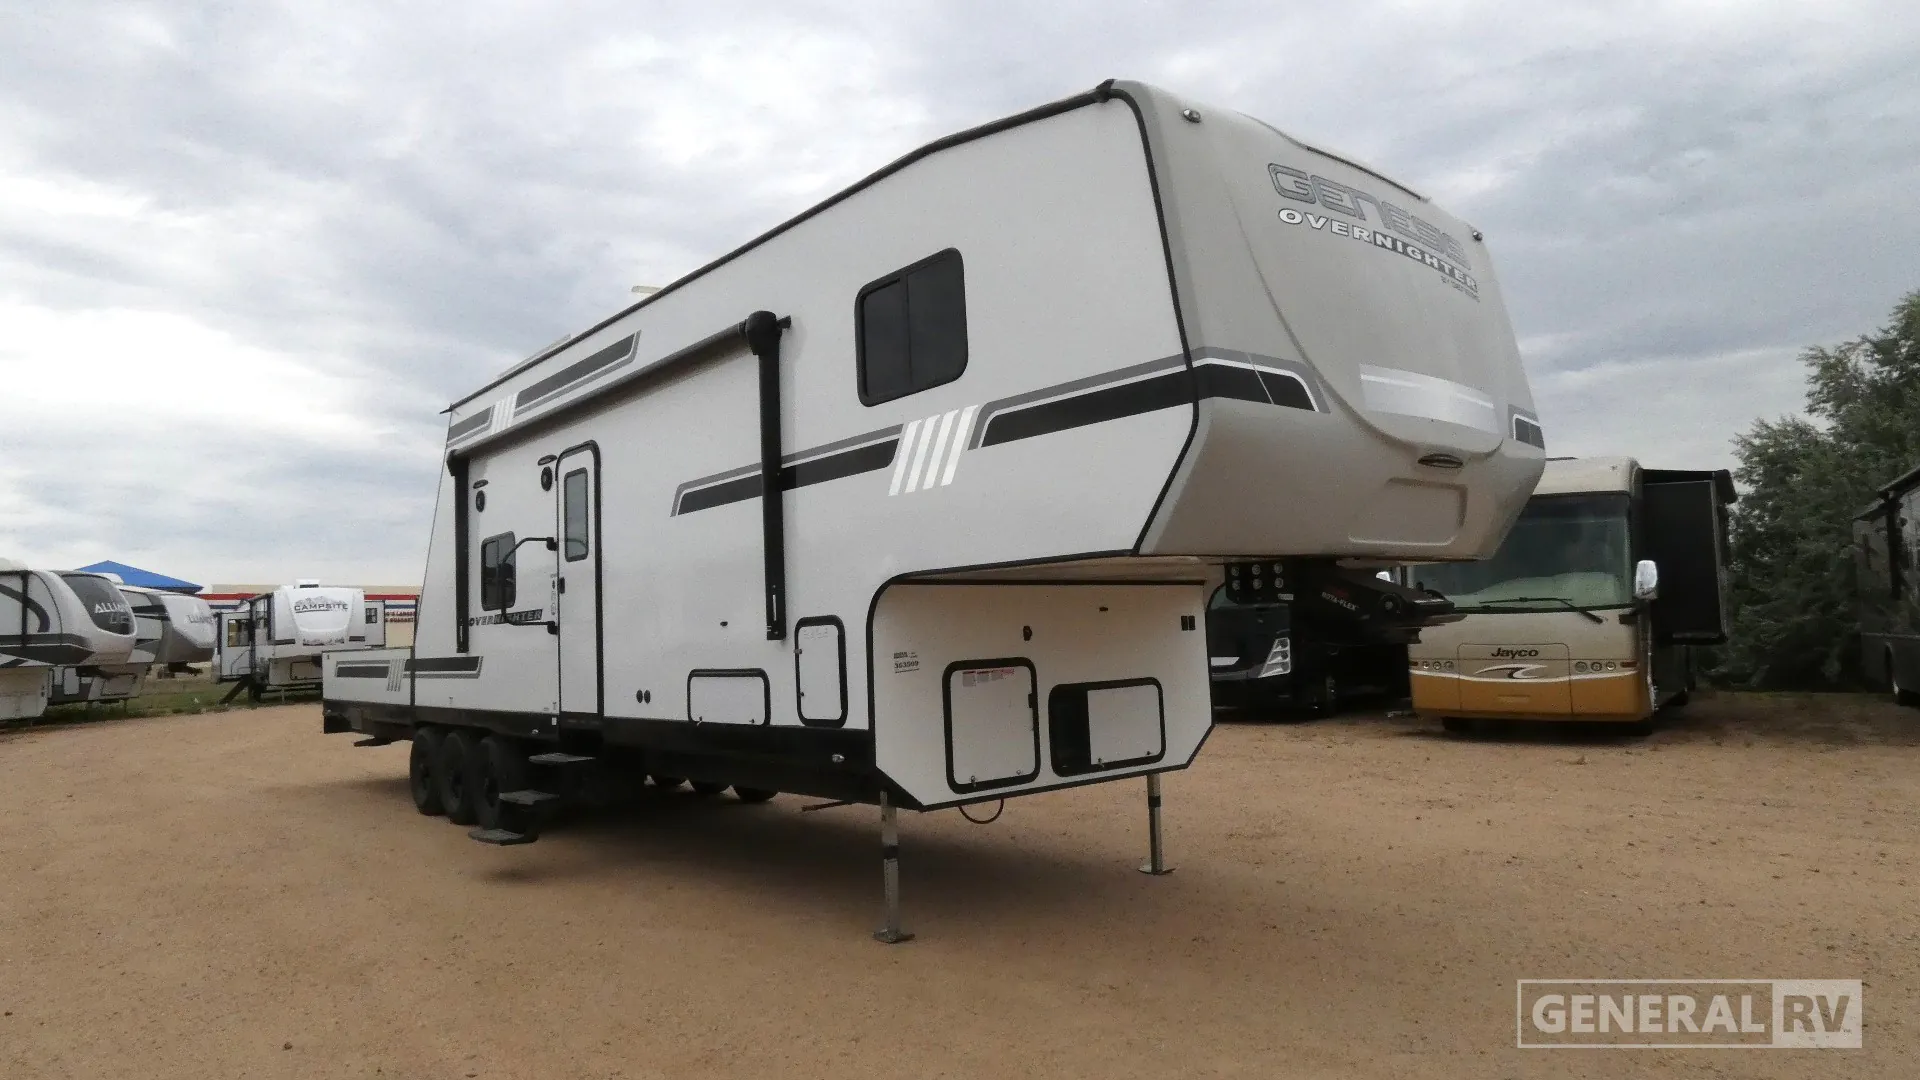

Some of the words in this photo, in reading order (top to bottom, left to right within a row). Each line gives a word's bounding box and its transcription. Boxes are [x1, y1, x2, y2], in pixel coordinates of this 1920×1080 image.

[1277, 207, 1478, 293] OVERNIGHTER
[294, 603, 349, 611] CAMPSITE
[468, 609, 543, 627] OVERNHTER
[1491, 647, 1539, 660] Jayco
